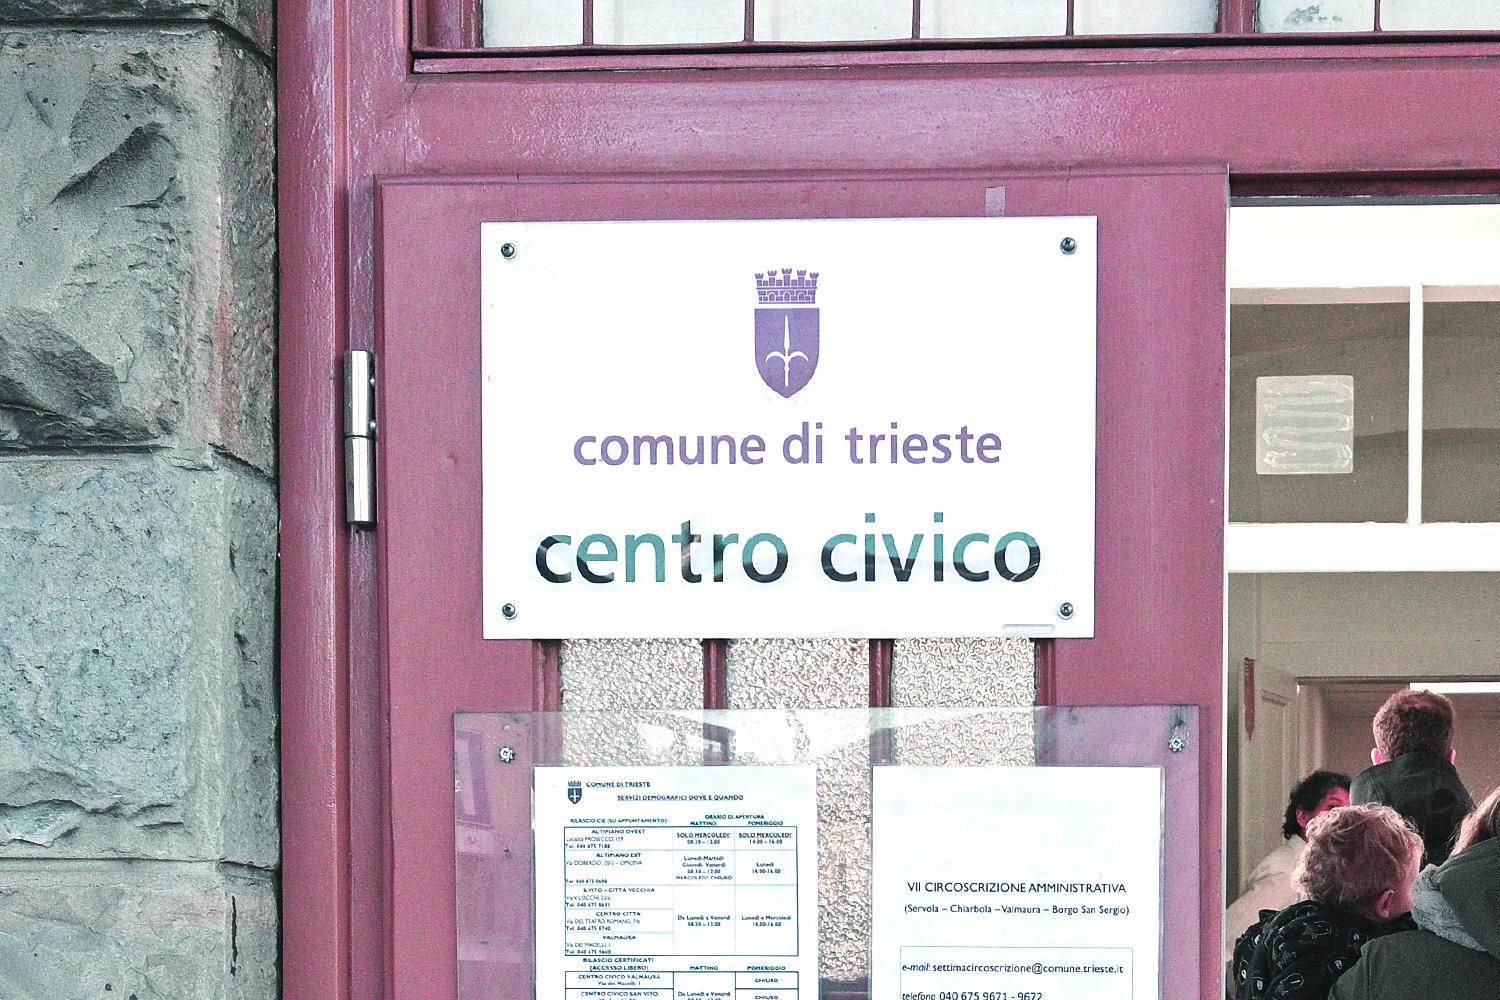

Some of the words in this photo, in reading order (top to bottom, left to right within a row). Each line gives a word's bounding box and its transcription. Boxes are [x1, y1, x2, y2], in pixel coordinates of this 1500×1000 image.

[573, 434, 766, 465] comune
[782, 422, 823, 465] di
[844, 422, 1002, 464] trieste
[536, 520, 788, 583] centro
[820, 512, 1042, 582] civico
[907, 882, 921, 893] VII
[924, 882, 1026, 893] CIRCOSCRIZIONE
[1028, 882, 1126, 894] AMMINISTRATIVA
[904, 904, 939, 914] (Servola
[950, 904, 992, 914] Chiarbola
[1001, 904, 1041, 914] Valmaura
[1052, 905, 1079, 916] Borgo
[1081, 905, 1096, 914] San
[1099, 905, 1130, 916] Sergio)
[901, 963, 931, 973] e-mail:
[932, 963, 1124, 975] settimacircoscrizione@comune.trieste.it
[939, 992, 959, 1000] 040
[960, 992, 980, 1000] 675
